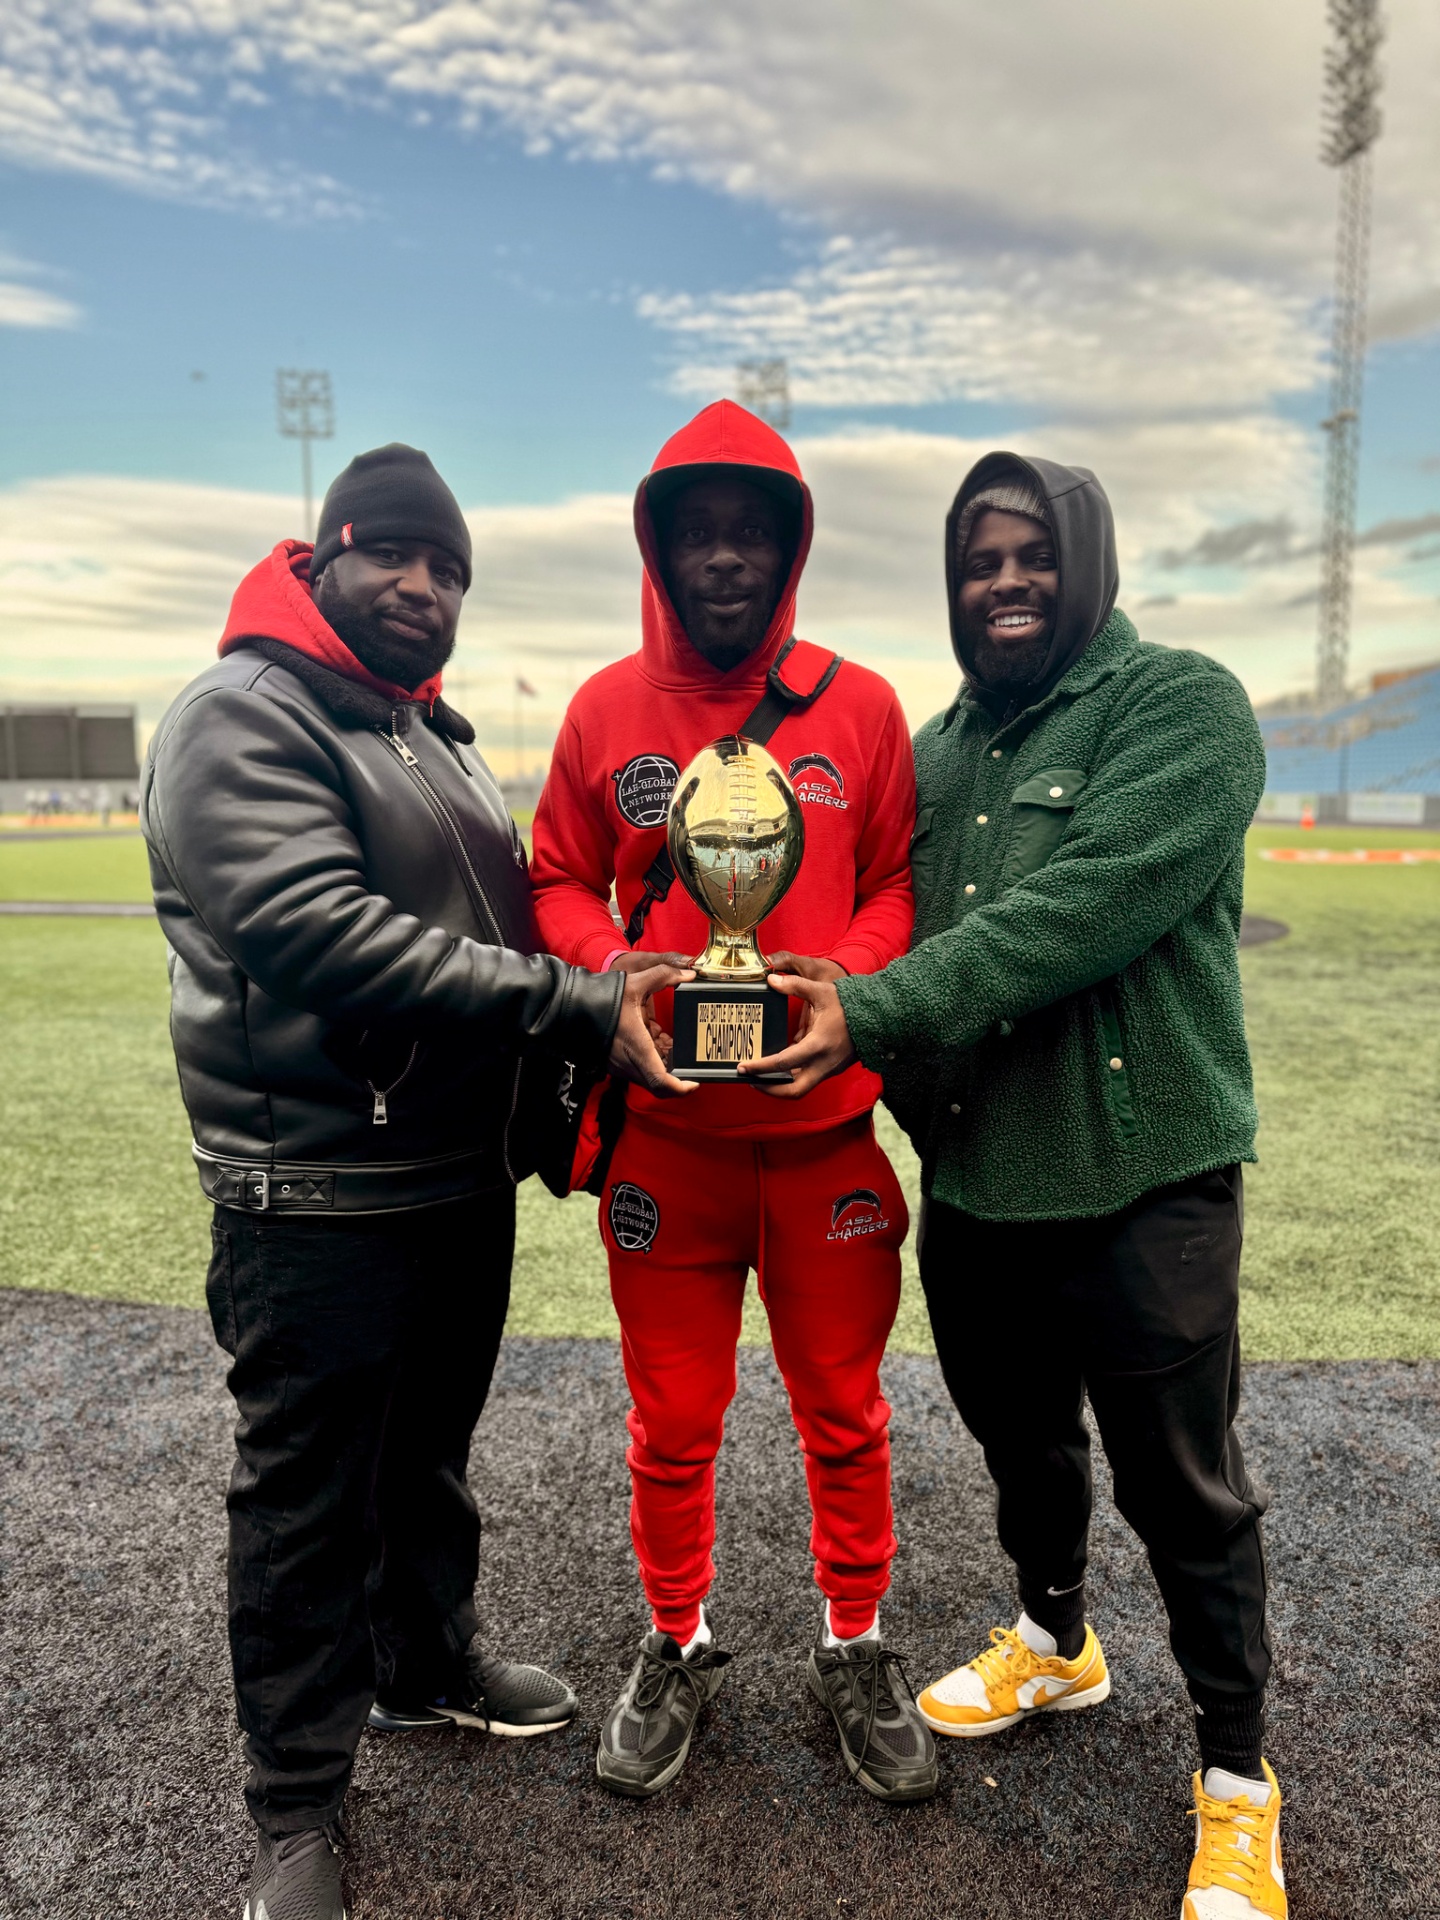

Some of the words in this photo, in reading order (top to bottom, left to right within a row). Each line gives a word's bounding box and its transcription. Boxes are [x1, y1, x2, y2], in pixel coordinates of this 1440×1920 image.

[796, 781, 832, 794] ASG
[628, 791, 673, 807] NETWORK
[799, 792, 850, 810] ARGERS
[711, 1004, 726, 1023] BATTLE
[728, 1004, 734, 1023] OF
[735, 1004, 744, 1023] THE
[745, 1004, 761, 1024] BRIDGE
[705, 1023, 754, 1061] CHAMPIONS
[616, 1214, 650, 1231] NETWORK
[842, 1213, 873, 1228] ASG
[826, 1219, 890, 1241] CHARGERS
